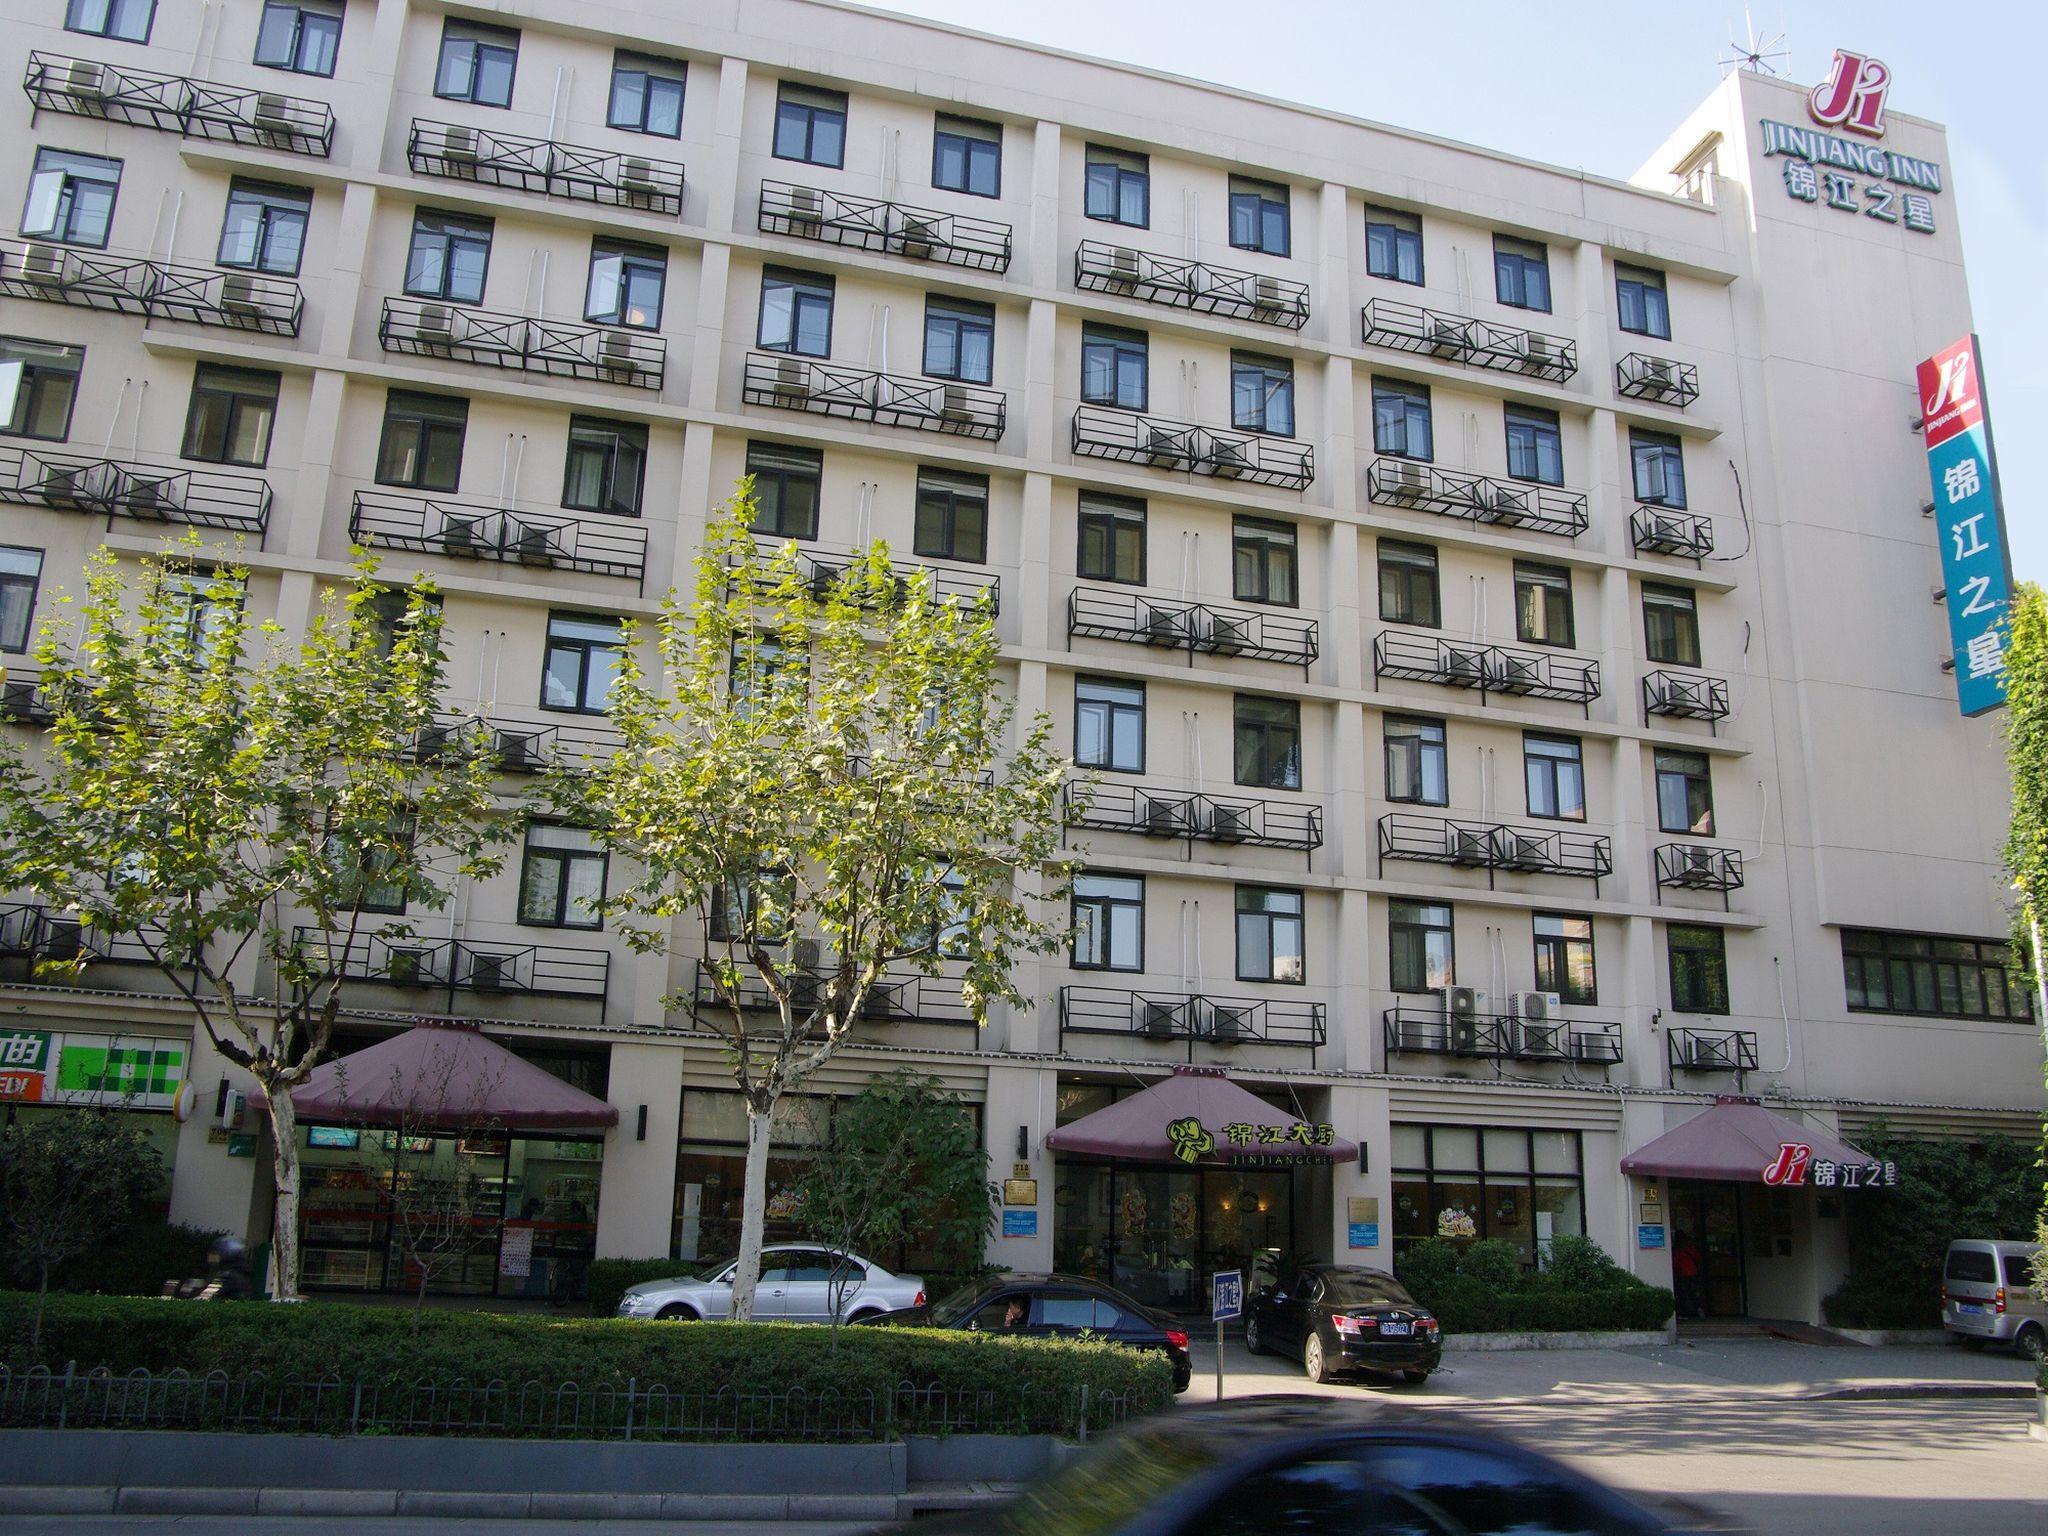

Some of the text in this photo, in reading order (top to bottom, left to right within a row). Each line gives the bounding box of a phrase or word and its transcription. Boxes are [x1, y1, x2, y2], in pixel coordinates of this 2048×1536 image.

[1761, 118, 1941, 194] JINJIANG INN
[1784, 159, 1936, 234] 锦江之星
[1943, 458, 2006, 680] 锦江之星
[0, 1034, 43, 1064] 的
[1222, 1121, 1335, 1147] 锦江大厨
[1814, 1160, 1896, 1188] 锦江之星
